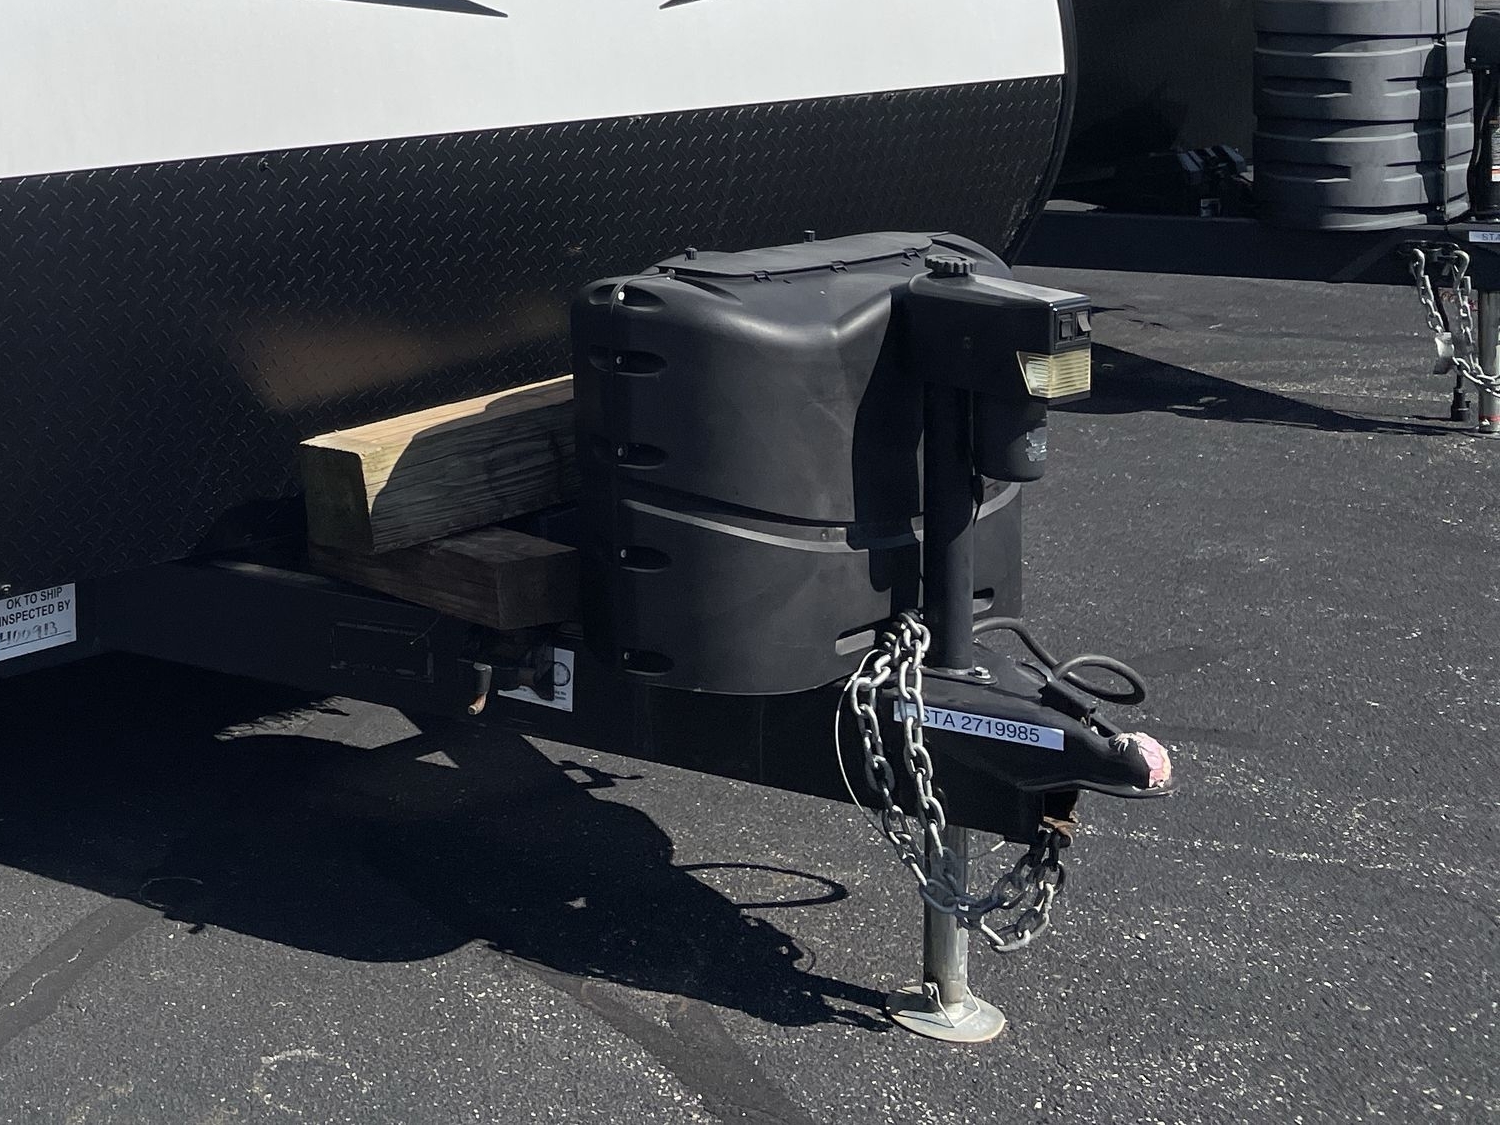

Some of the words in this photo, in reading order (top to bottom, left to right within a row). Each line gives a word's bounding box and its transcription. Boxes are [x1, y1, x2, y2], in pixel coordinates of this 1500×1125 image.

[6, 597, 22, 610] OK
[24, 593, 38, 606] TO
[40, 586, 63, 602] SHIP
[0, 603, 55, 627] INSPECTED
[57, 599, 71, 612] BY
[961, 715, 1040, 743] 2719985
